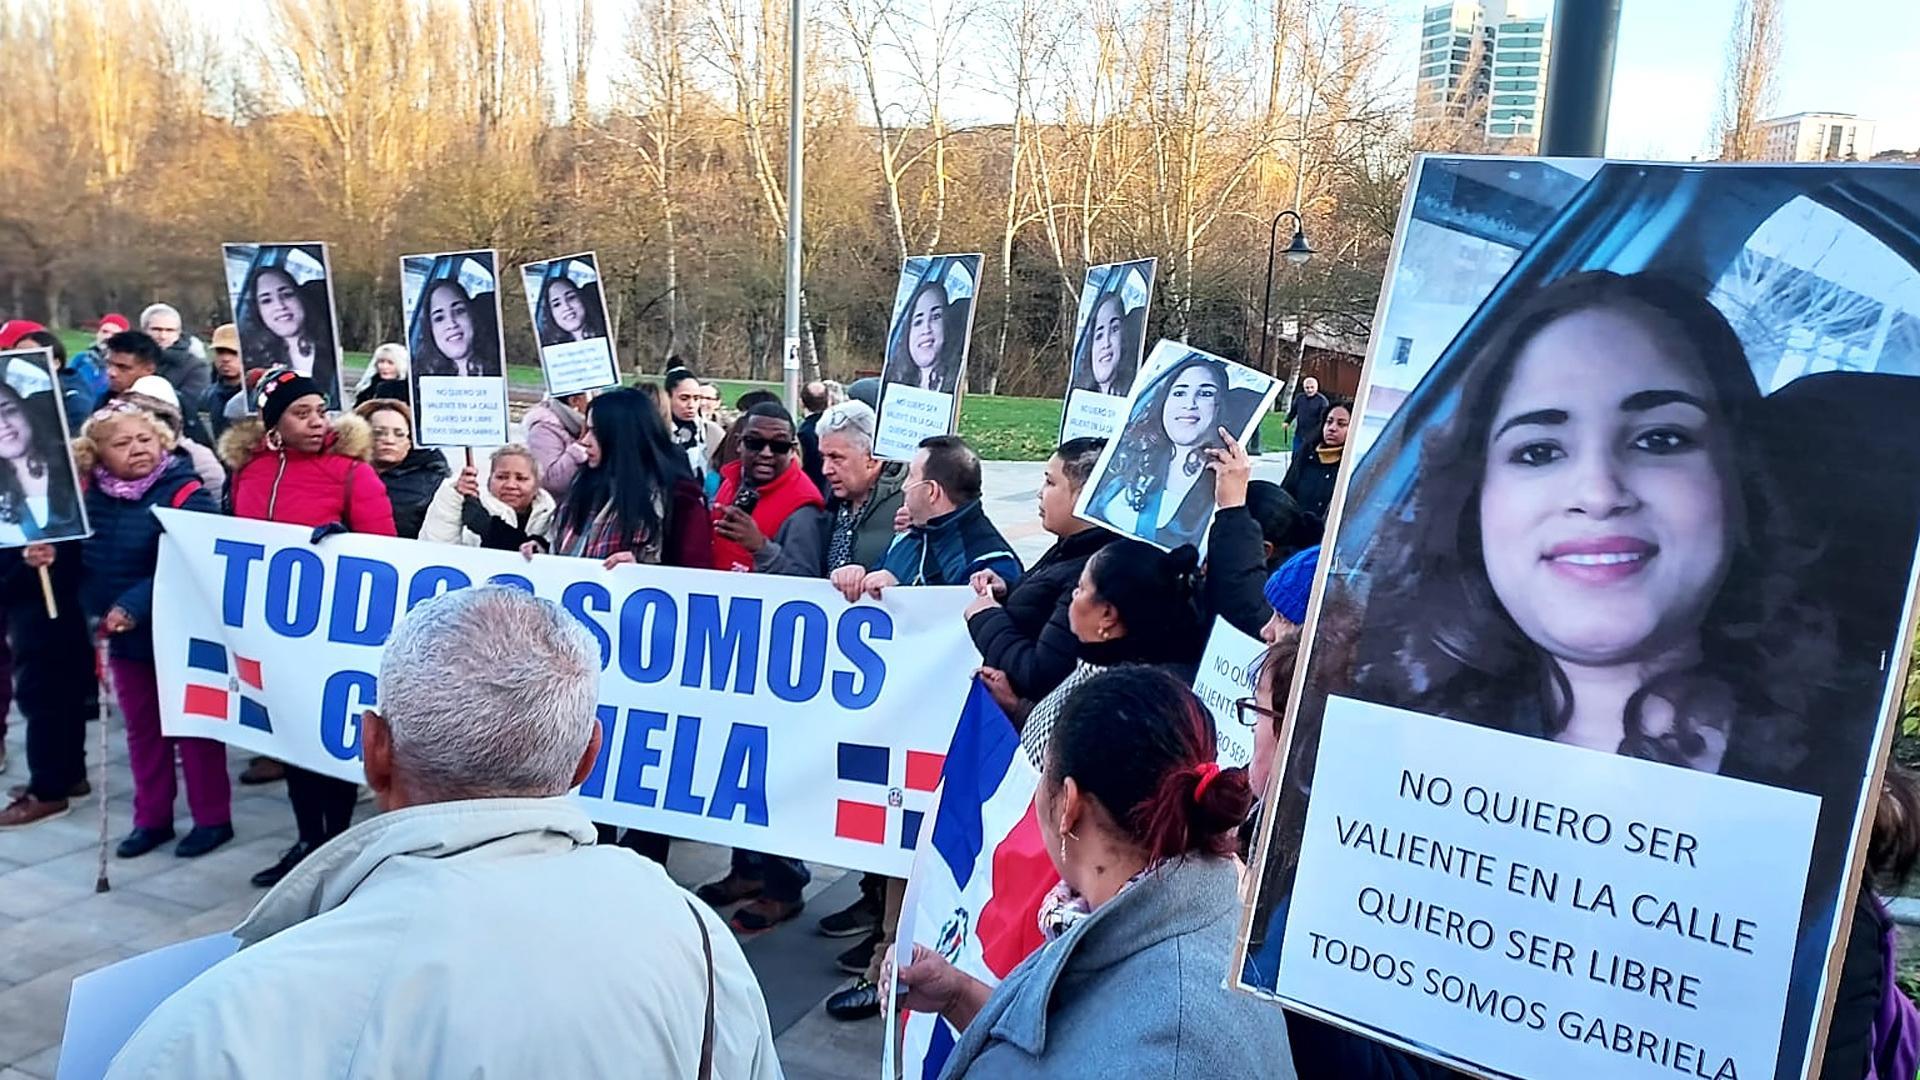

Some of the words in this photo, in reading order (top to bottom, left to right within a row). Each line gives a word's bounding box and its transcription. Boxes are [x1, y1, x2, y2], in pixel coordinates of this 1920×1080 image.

[214, 538, 535, 647] TOD
[1214, 655, 1230, 676] NO
[320, 670, 770, 827] GIELA
[1400, 769, 1453, 807] NO
[1463, 785, 1612, 846] QUIERO
[1623, 821, 1699, 868] SER
[1335, 815, 1498, 886] VALIENTE
[1508, 863, 1560, 903] EN
[1572, 877, 1618, 918] LA
[1631, 893, 1758, 955] CALLE
[1309, 931, 1416, 988] TODOS
[1424, 967, 1547, 1031] SOMOS
[1557, 1010, 1741, 1080] GABRIELA
[1358, 886, 1495, 951] QUIERO
[1506, 929, 1575, 977] SER
[1588, 949, 1702, 1011] LIBRE
